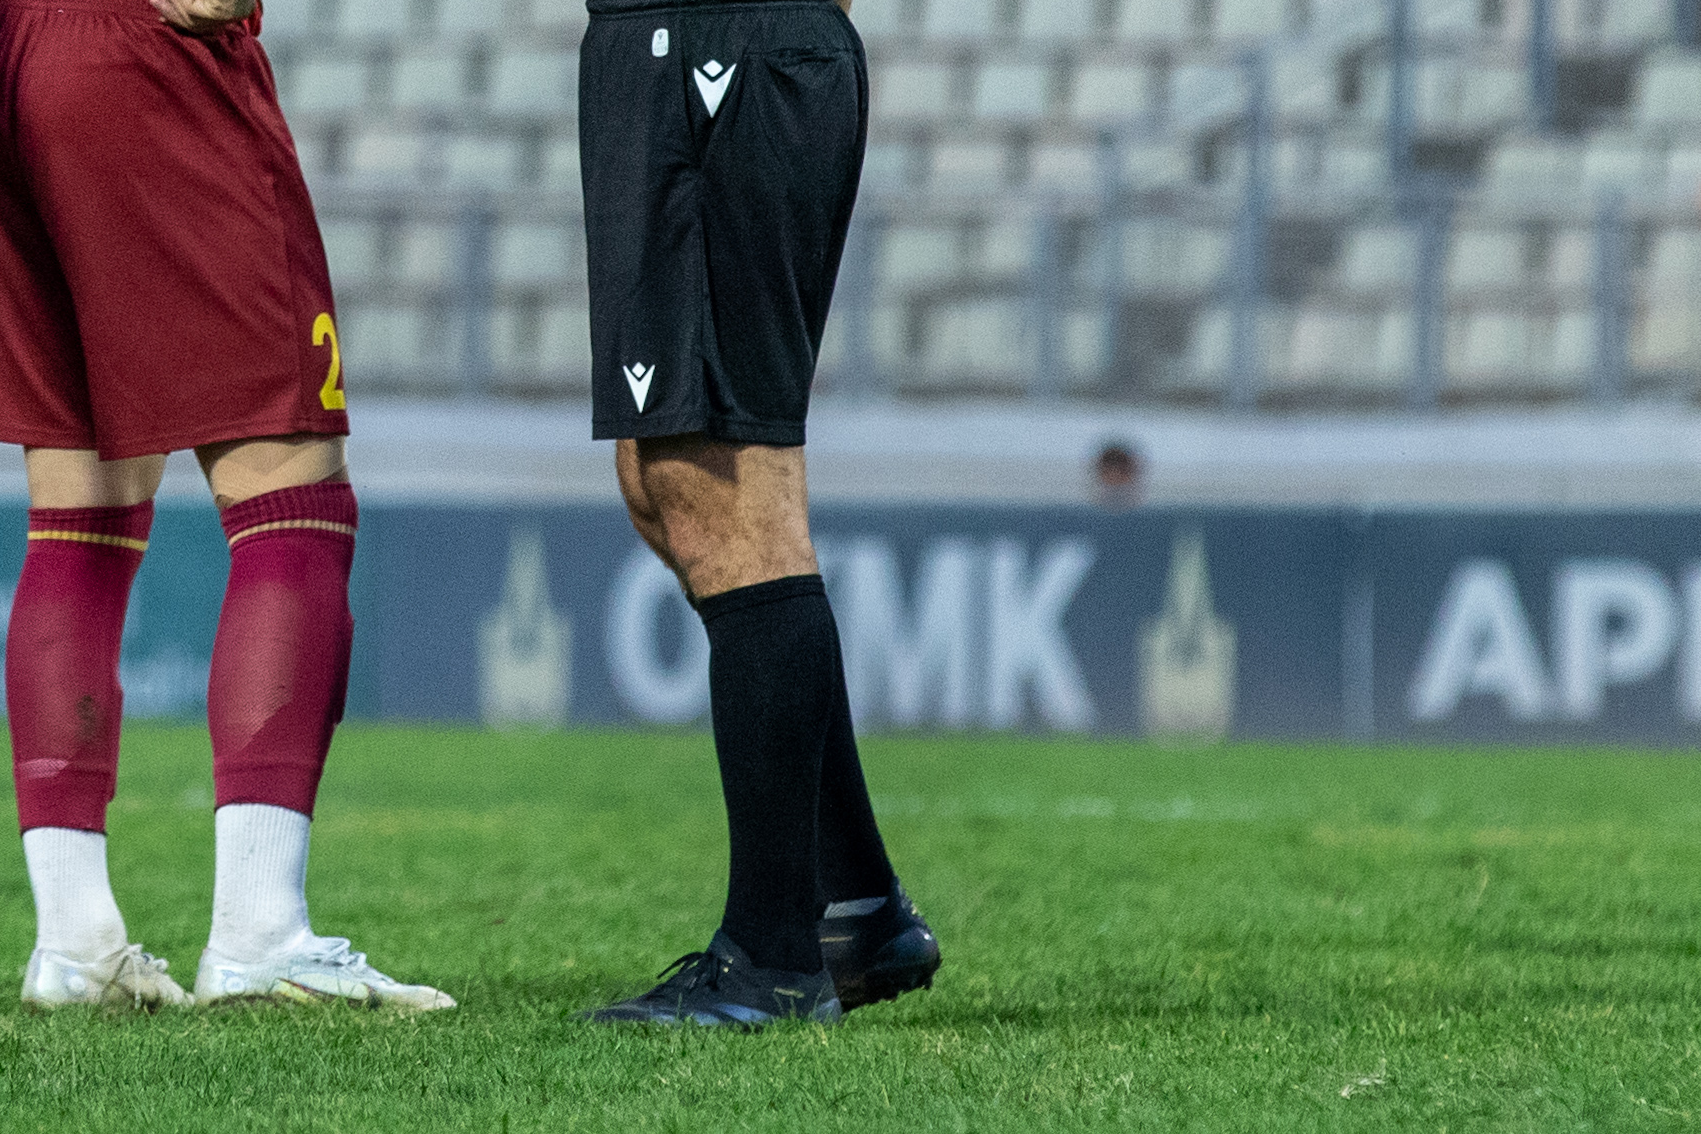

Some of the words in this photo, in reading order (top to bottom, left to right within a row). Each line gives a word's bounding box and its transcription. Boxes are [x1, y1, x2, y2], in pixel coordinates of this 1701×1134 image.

[311, 312, 347, 411] 2
[604, 536, 1095, 729] OMK
[1411, 558, 1701, 720] AP
